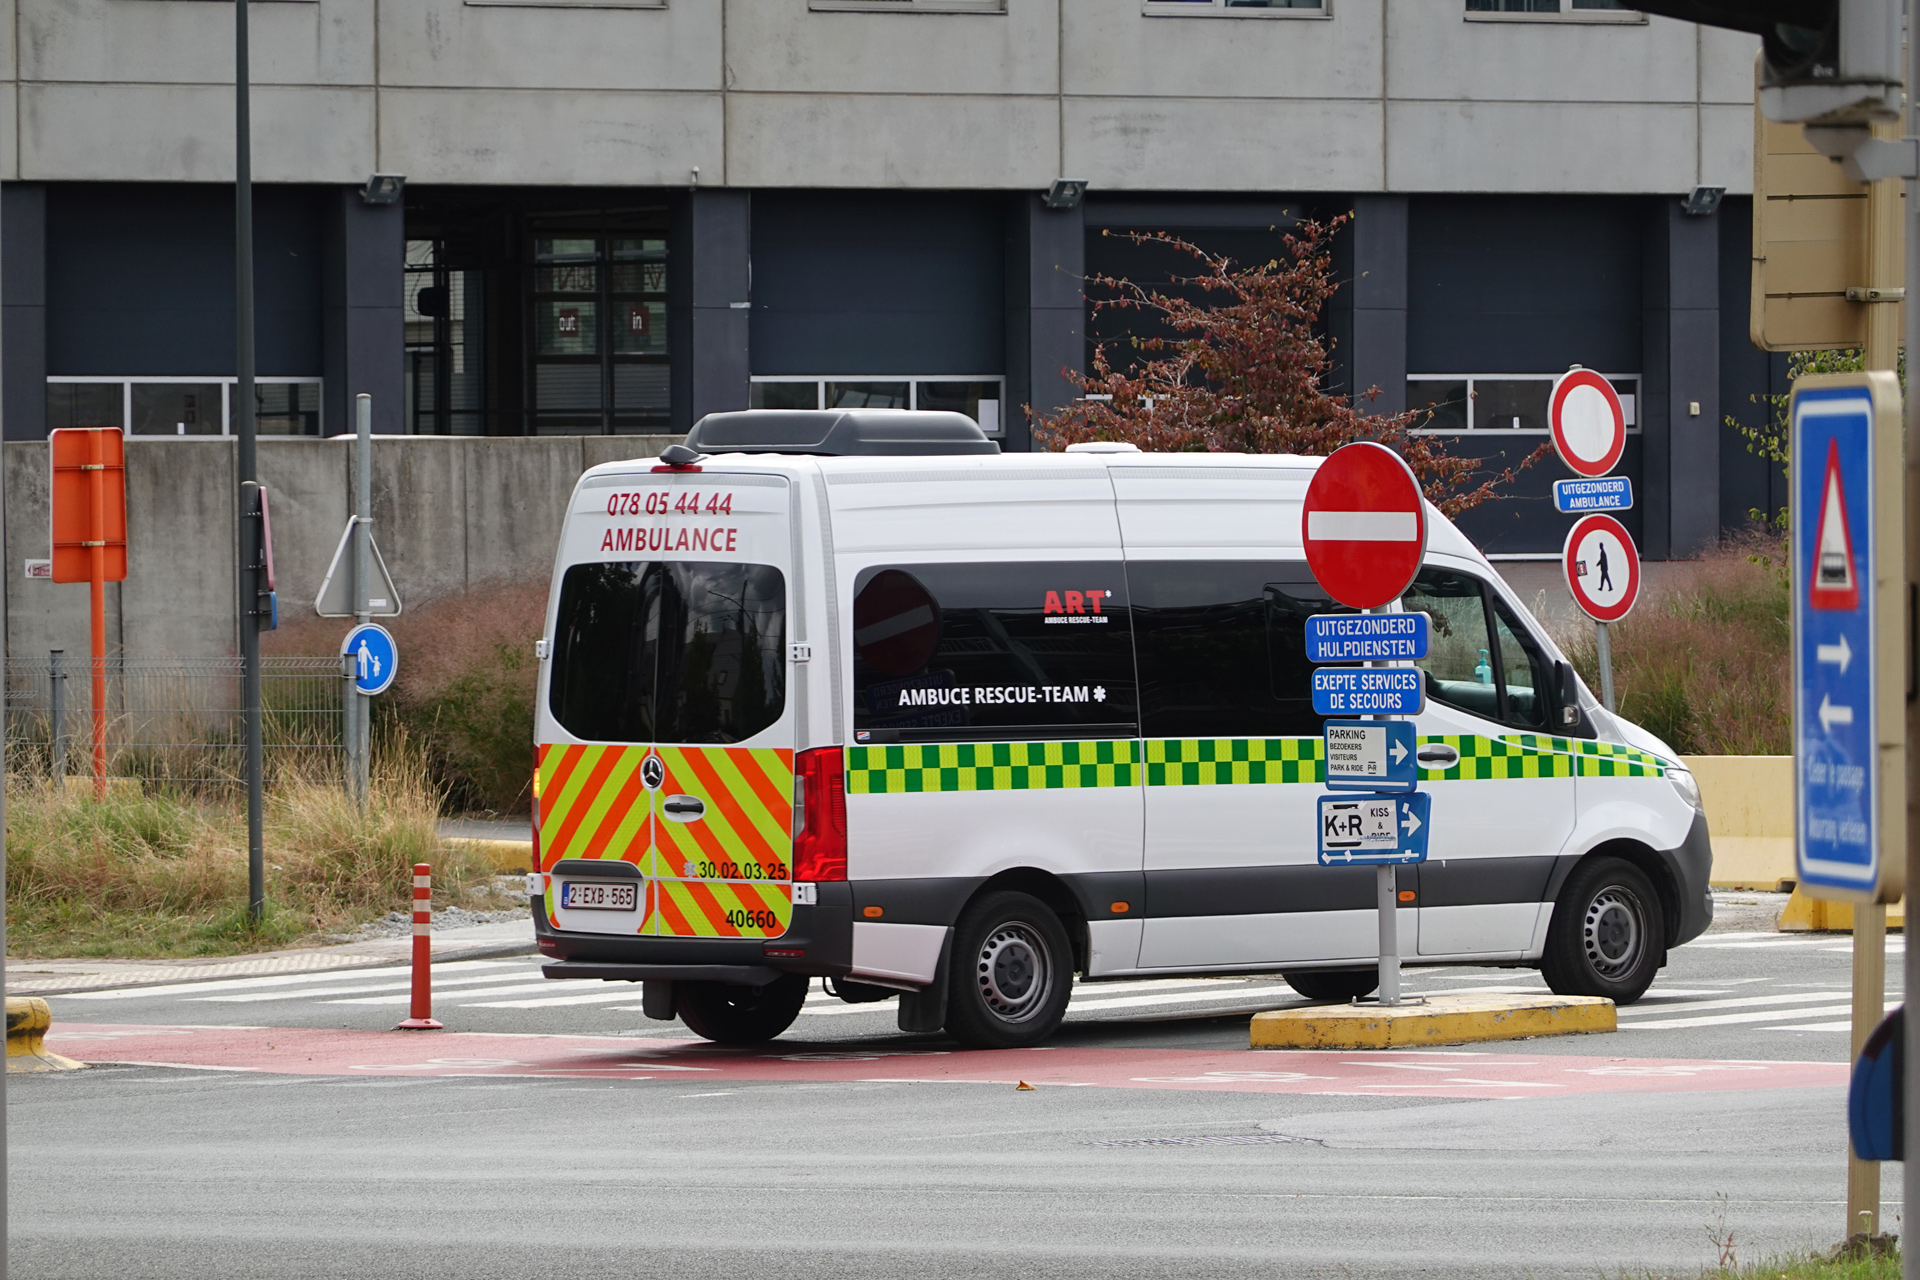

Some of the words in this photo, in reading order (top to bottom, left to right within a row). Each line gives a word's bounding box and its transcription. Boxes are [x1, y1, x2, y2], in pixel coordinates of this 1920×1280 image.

[559, 315, 576, 331] out
[632, 311, 642, 330] in
[1562, 481, 1624, 495] UITGEZONDERD
[607, 493, 641, 516] 078
[645, 492, 670, 515] 05
[675, 492, 700, 514] 44
[706, 492, 732, 515] 44
[1569, 495, 1621, 509] AMBULANCE
[600, 527, 738, 552] AMBULANCE
[1043, 590, 1105, 614] ART
[1044, 616, 1068, 624] AMBUCE
[1068, 616, 1108, 624] RESCUE-TEAM
[1316, 618, 1416, 636] UITGEZONDERD
[1318, 639, 1416, 657] HULPDIENSTEN
[1315, 674, 1357, 690] EXEPTE
[1361, 673, 1417, 690] SERVICES
[899, 688, 970, 706] AMBUCE
[974, 686, 1089, 704] RESCUE-TEAM
[1330, 693, 1345, 709] DE
[1349, 693, 1402, 709] SECOURS
[1329, 729, 1366, 740] PARKING
[1329, 743, 1362, 751] BEZOEKERS
[1330, 753, 1358, 761] VISITEURS
[1330, 763, 1345, 771] PARK
[1350, 764, 1363, 772] RIDE
[1370, 807, 1390, 818] KISS
[1325, 815, 1363, 837] K+R
[1377, 821, 1384, 830] &
[699, 861, 787, 880] 30.02.03.25
[725, 909, 776, 928] 40660
